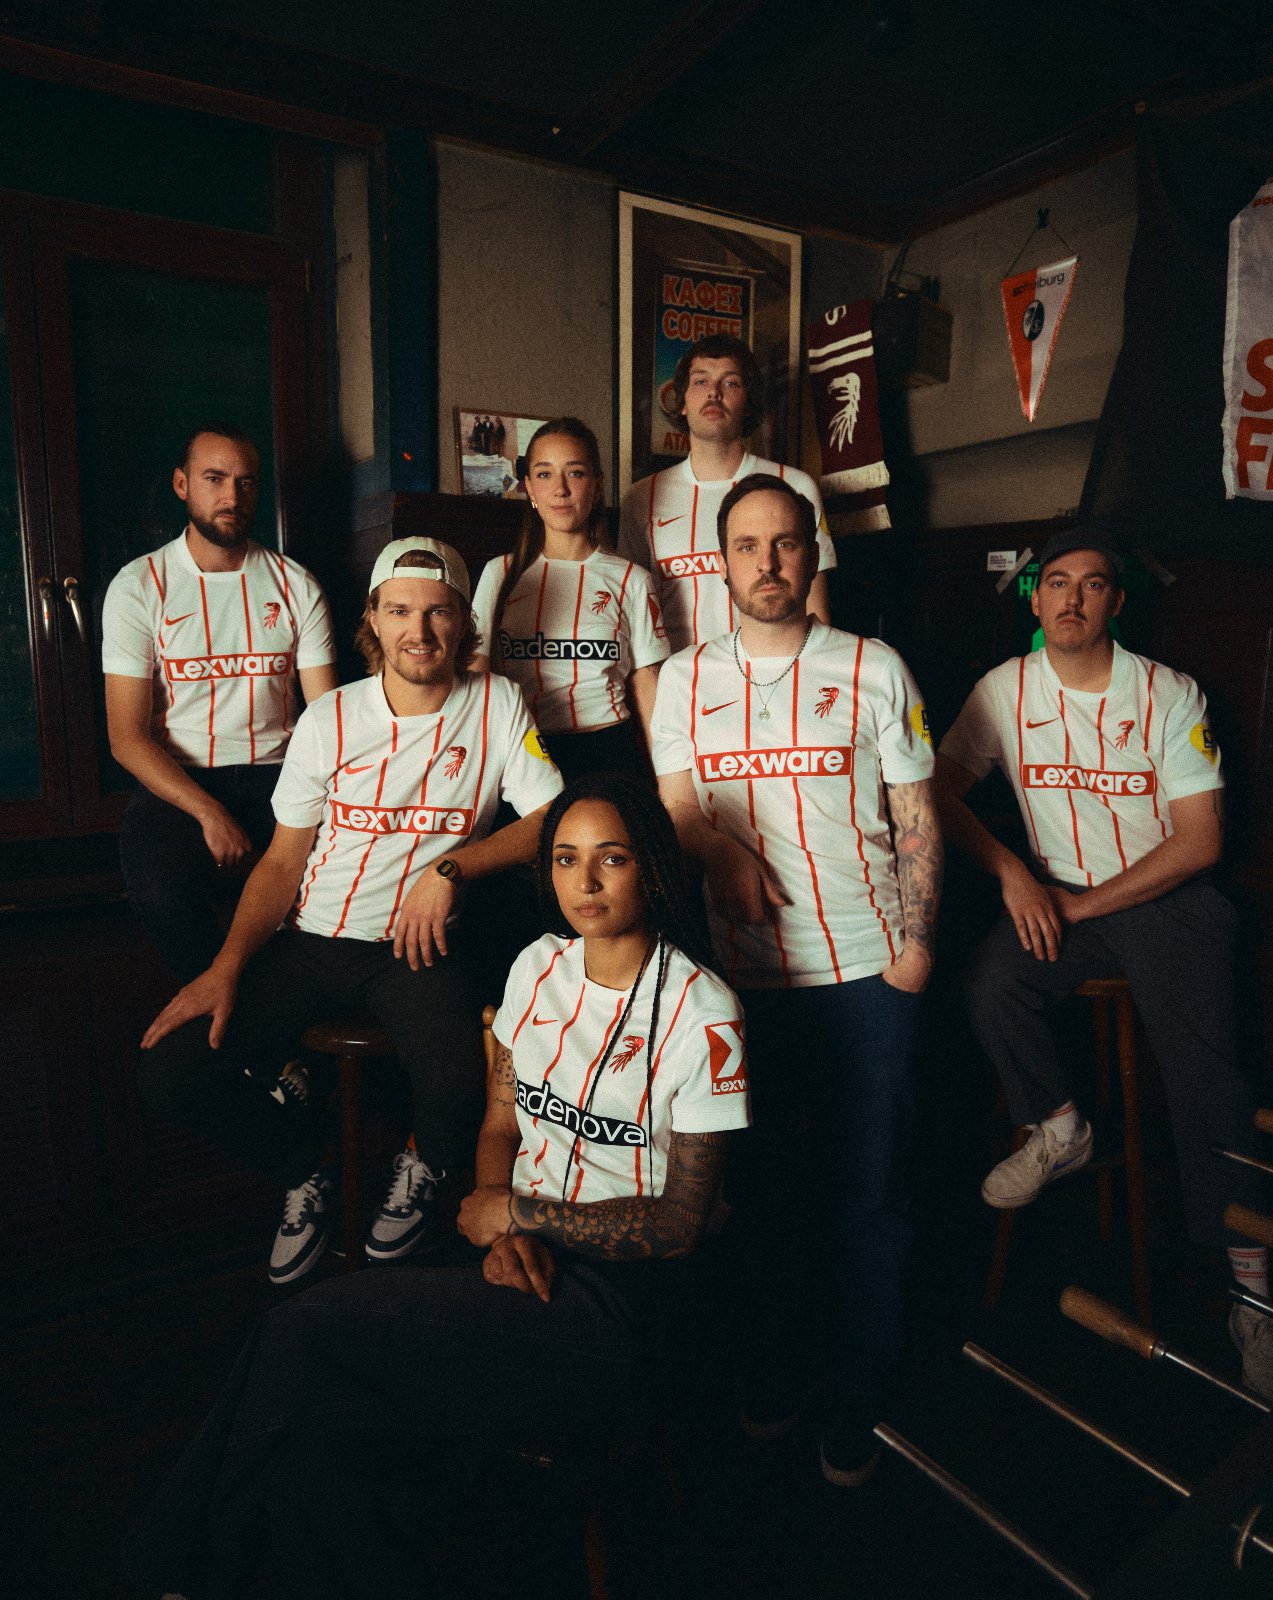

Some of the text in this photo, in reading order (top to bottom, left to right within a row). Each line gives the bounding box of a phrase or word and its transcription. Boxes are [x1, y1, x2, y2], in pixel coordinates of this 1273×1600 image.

[169, 655, 288, 680] Lexware
[703, 749, 844, 779] Lexware
[1029, 767, 1148, 794] Lexware
[336, 805, 466, 832] Lexware
[515, 1082, 646, 1145] adenova
